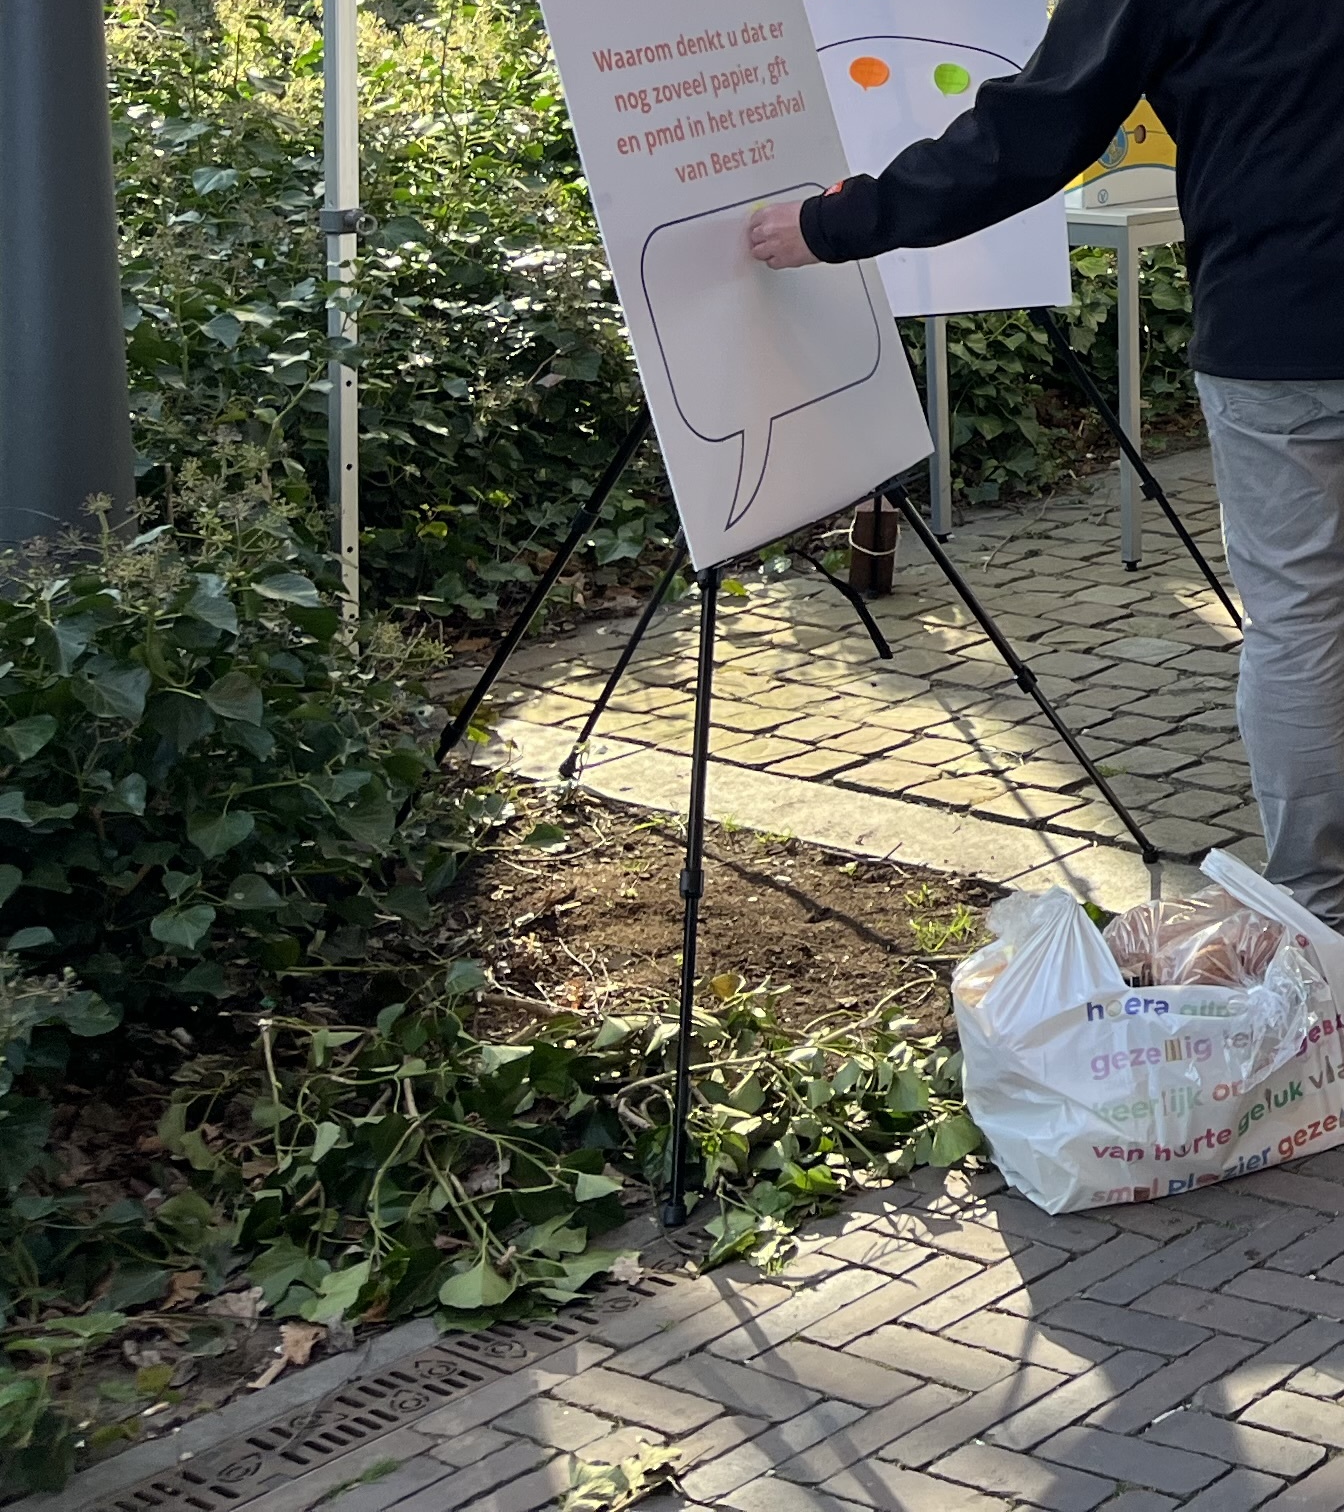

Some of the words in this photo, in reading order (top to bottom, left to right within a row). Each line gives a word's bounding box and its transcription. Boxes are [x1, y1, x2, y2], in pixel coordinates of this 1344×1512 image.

[592, 42, 674, 73] Waarom
[676, 28, 726, 57] denkt
[727, 31, 739, 48] u
[741, 22, 768, 45] dat
[769, 21, 785, 39] er
[614, 88, 652, 114] nog
[652, 71, 708, 105] zoveel
[710, 63, 767, 98] papier,
[767, 55, 790, 85] gft
[616, 133, 642, 155] en
[644, 117, 685, 156] pmd
[686, 115, 706, 138] in
[706, 109, 737, 134] het
[738, 90, 806, 127] restafval
[675, 159, 709, 184] van
[710, 147, 748, 175] Best
[749, 138, 775, 164] zit?
[1092, 1145, 1145, 1162] van
